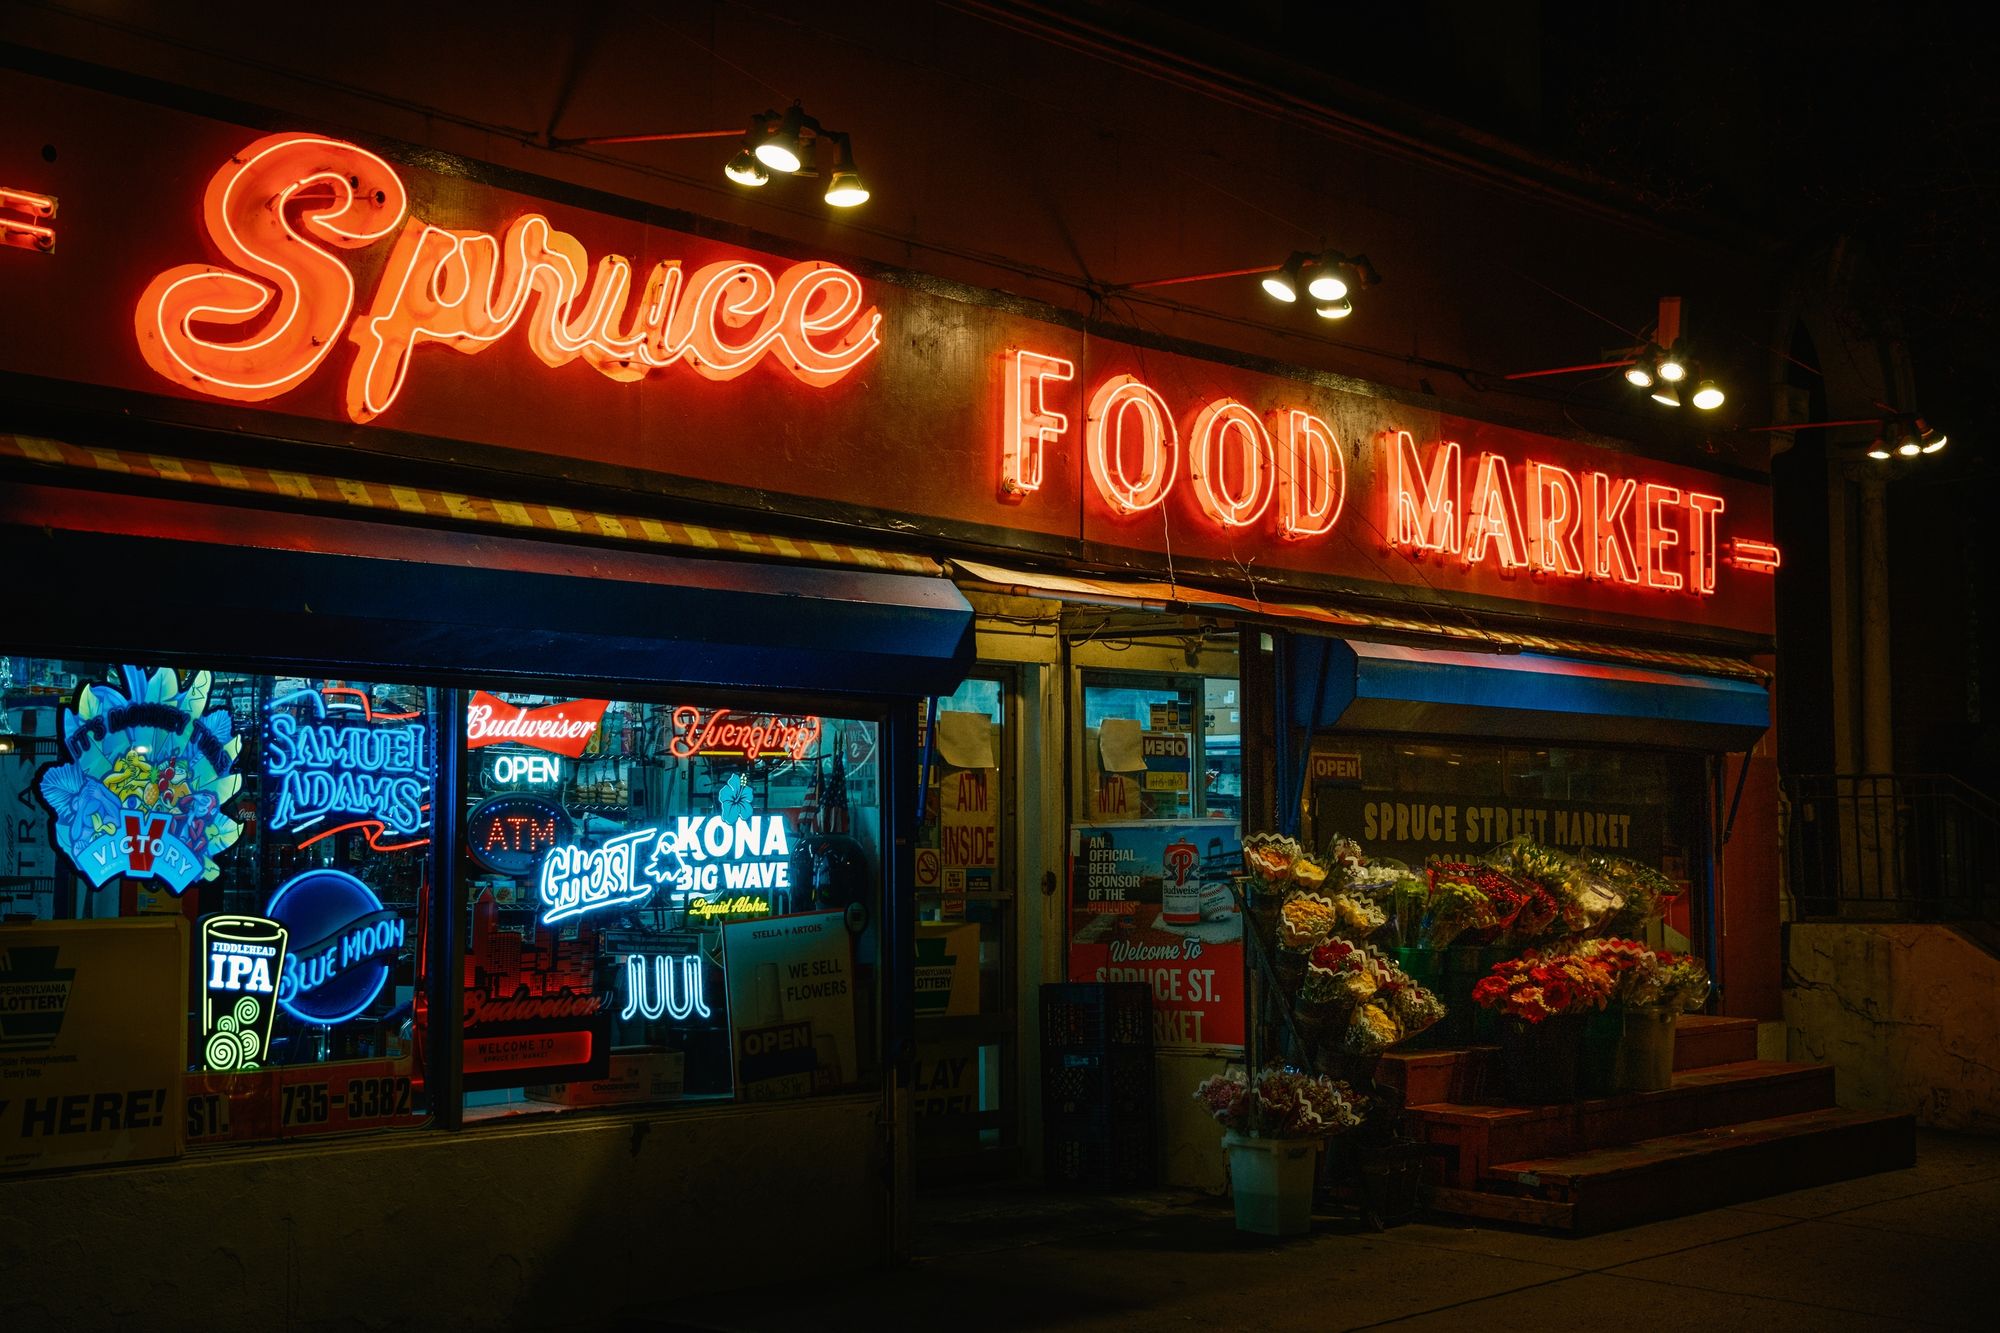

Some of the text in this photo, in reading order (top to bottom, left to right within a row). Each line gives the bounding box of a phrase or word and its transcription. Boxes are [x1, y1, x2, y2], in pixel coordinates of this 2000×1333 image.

[134, 131, 1726, 597] Spruce FOOD MARKET
[467, 703, 597, 739] Budweiser
[669, 705, 821, 760] Yuengling
[267, 713, 430, 775] SAMUEL
[494, 755, 560, 785] OPEN
[1316, 758, 1357, 779] OPEN
[269, 769, 423, 835] ADAMS
[957, 772, 988, 813] ATM
[484, 817, 555, 851] ATM
[677, 815, 789, 860] KONA
[1364, 802, 1632, 849] SPRUCE STREET MARKET
[93, 834, 194, 876] VICTORY
[943, 825, 996, 866] INSIDE
[1088, 848, 1136, 862] OFFICIAL
[1089, 836, 1105, 849] AN
[676, 861, 791, 892] BIG WAVE
[1087, 874, 1141, 888] SPONSOR
[1088, 862, 1117, 875] BEER
[688, 896, 730, 920] Liquid
[1088, 888, 1126, 901] OF THE
[752, 923, 823, 940] STELLA ARTOIS
[211, 940, 277, 957] FIDDLEHEAD
[277, 917, 405, 1004] BLUE MOON
[1110, 936, 1203, 962] Welcome To
[208, 952, 274, 993] IPA
[788, 958, 843, 980] WE SELL
[0, 982, 67, 996] PENNSYLVANIA
[786, 980, 848, 1002] FLOWERS
[1187, 968, 1222, 1004] ST.
[479, 1038, 554, 1054] WELCOME TO
[744, 1025, 811, 1057] OPEN
[20, 1087, 168, 1139] HERE!
[187, 1077, 412, 1138] ST. 735-3382
